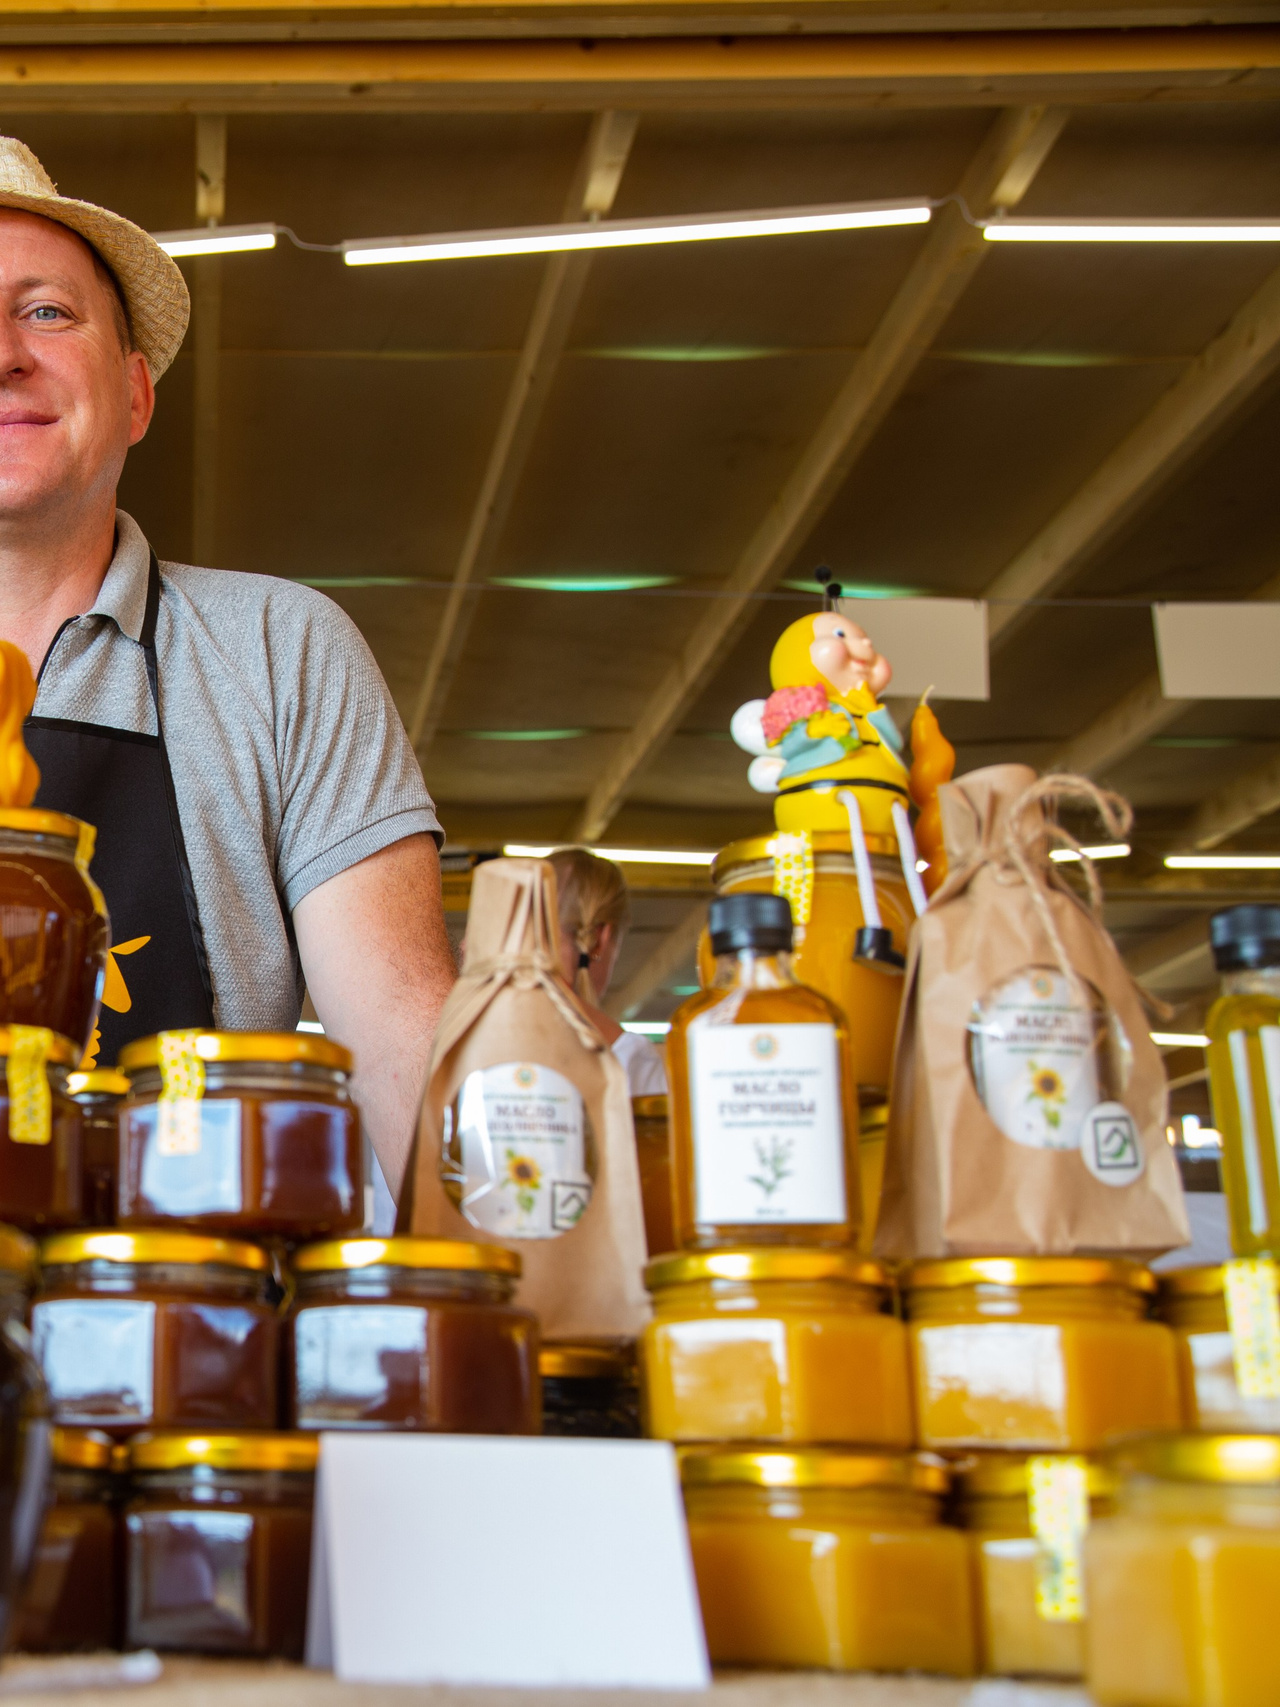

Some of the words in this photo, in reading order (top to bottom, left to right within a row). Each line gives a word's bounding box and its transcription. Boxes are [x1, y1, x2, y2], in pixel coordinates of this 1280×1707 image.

[1015, 1014, 1071, 1028] МАСЛ
[733, 1080, 801, 1095] МАСЛО
[494, 1103, 556, 1119] МАСЛО
